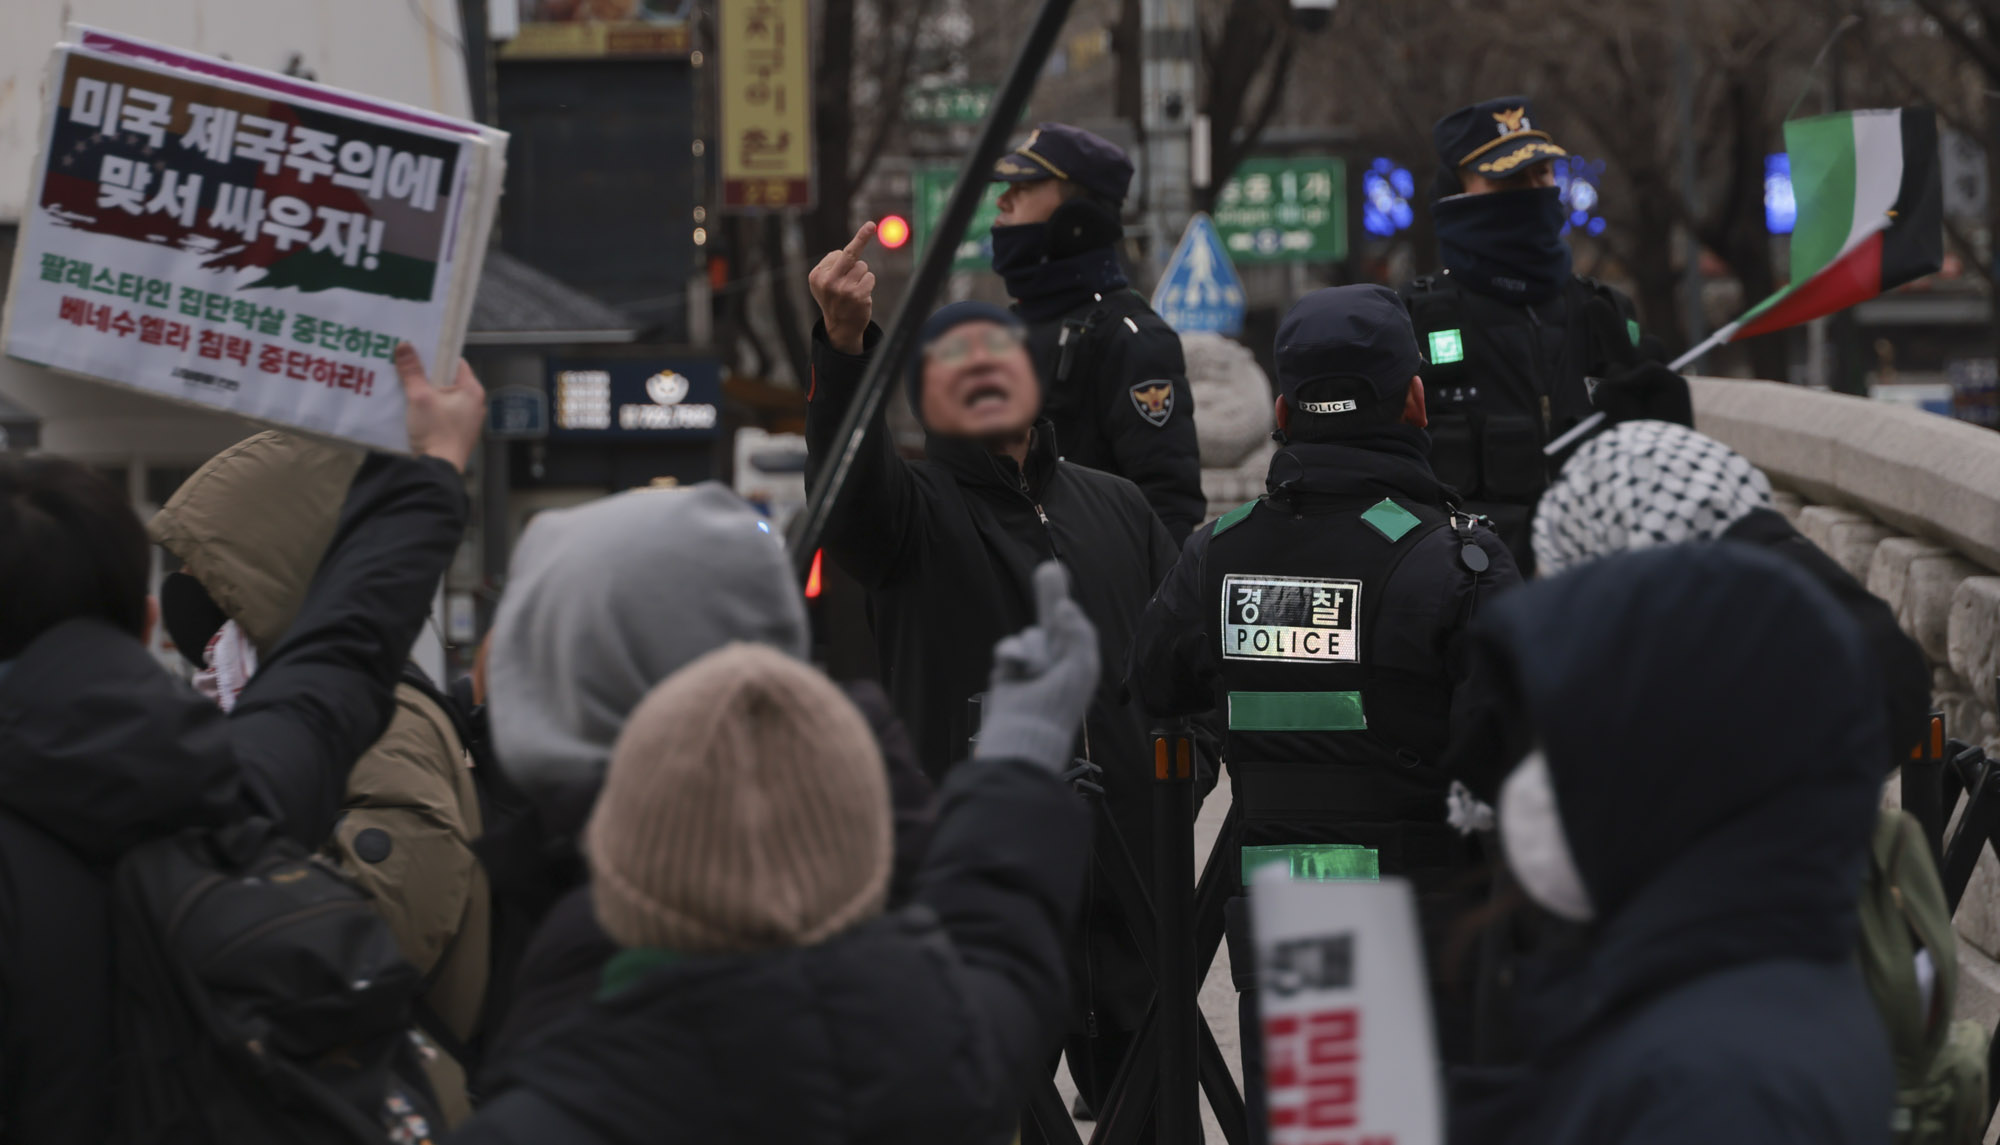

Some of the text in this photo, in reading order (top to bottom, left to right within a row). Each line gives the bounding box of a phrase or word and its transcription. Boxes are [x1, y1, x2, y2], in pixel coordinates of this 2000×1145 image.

[69, 77, 443, 212] 미국 제국주의에
[97, 154, 385, 270] 맞서 싸우자!
[39, 252, 172, 309] 팔레스타인
[177, 285, 286, 337] 집단학살
[58, 295, 191, 352] 베네수엘라
[197, 328, 253, 367] 침략
[257, 342, 376, 396] 중단하라!
[1301, 402, 1352, 412] POLICE
[1237, 628, 1340, 655] POLICE
